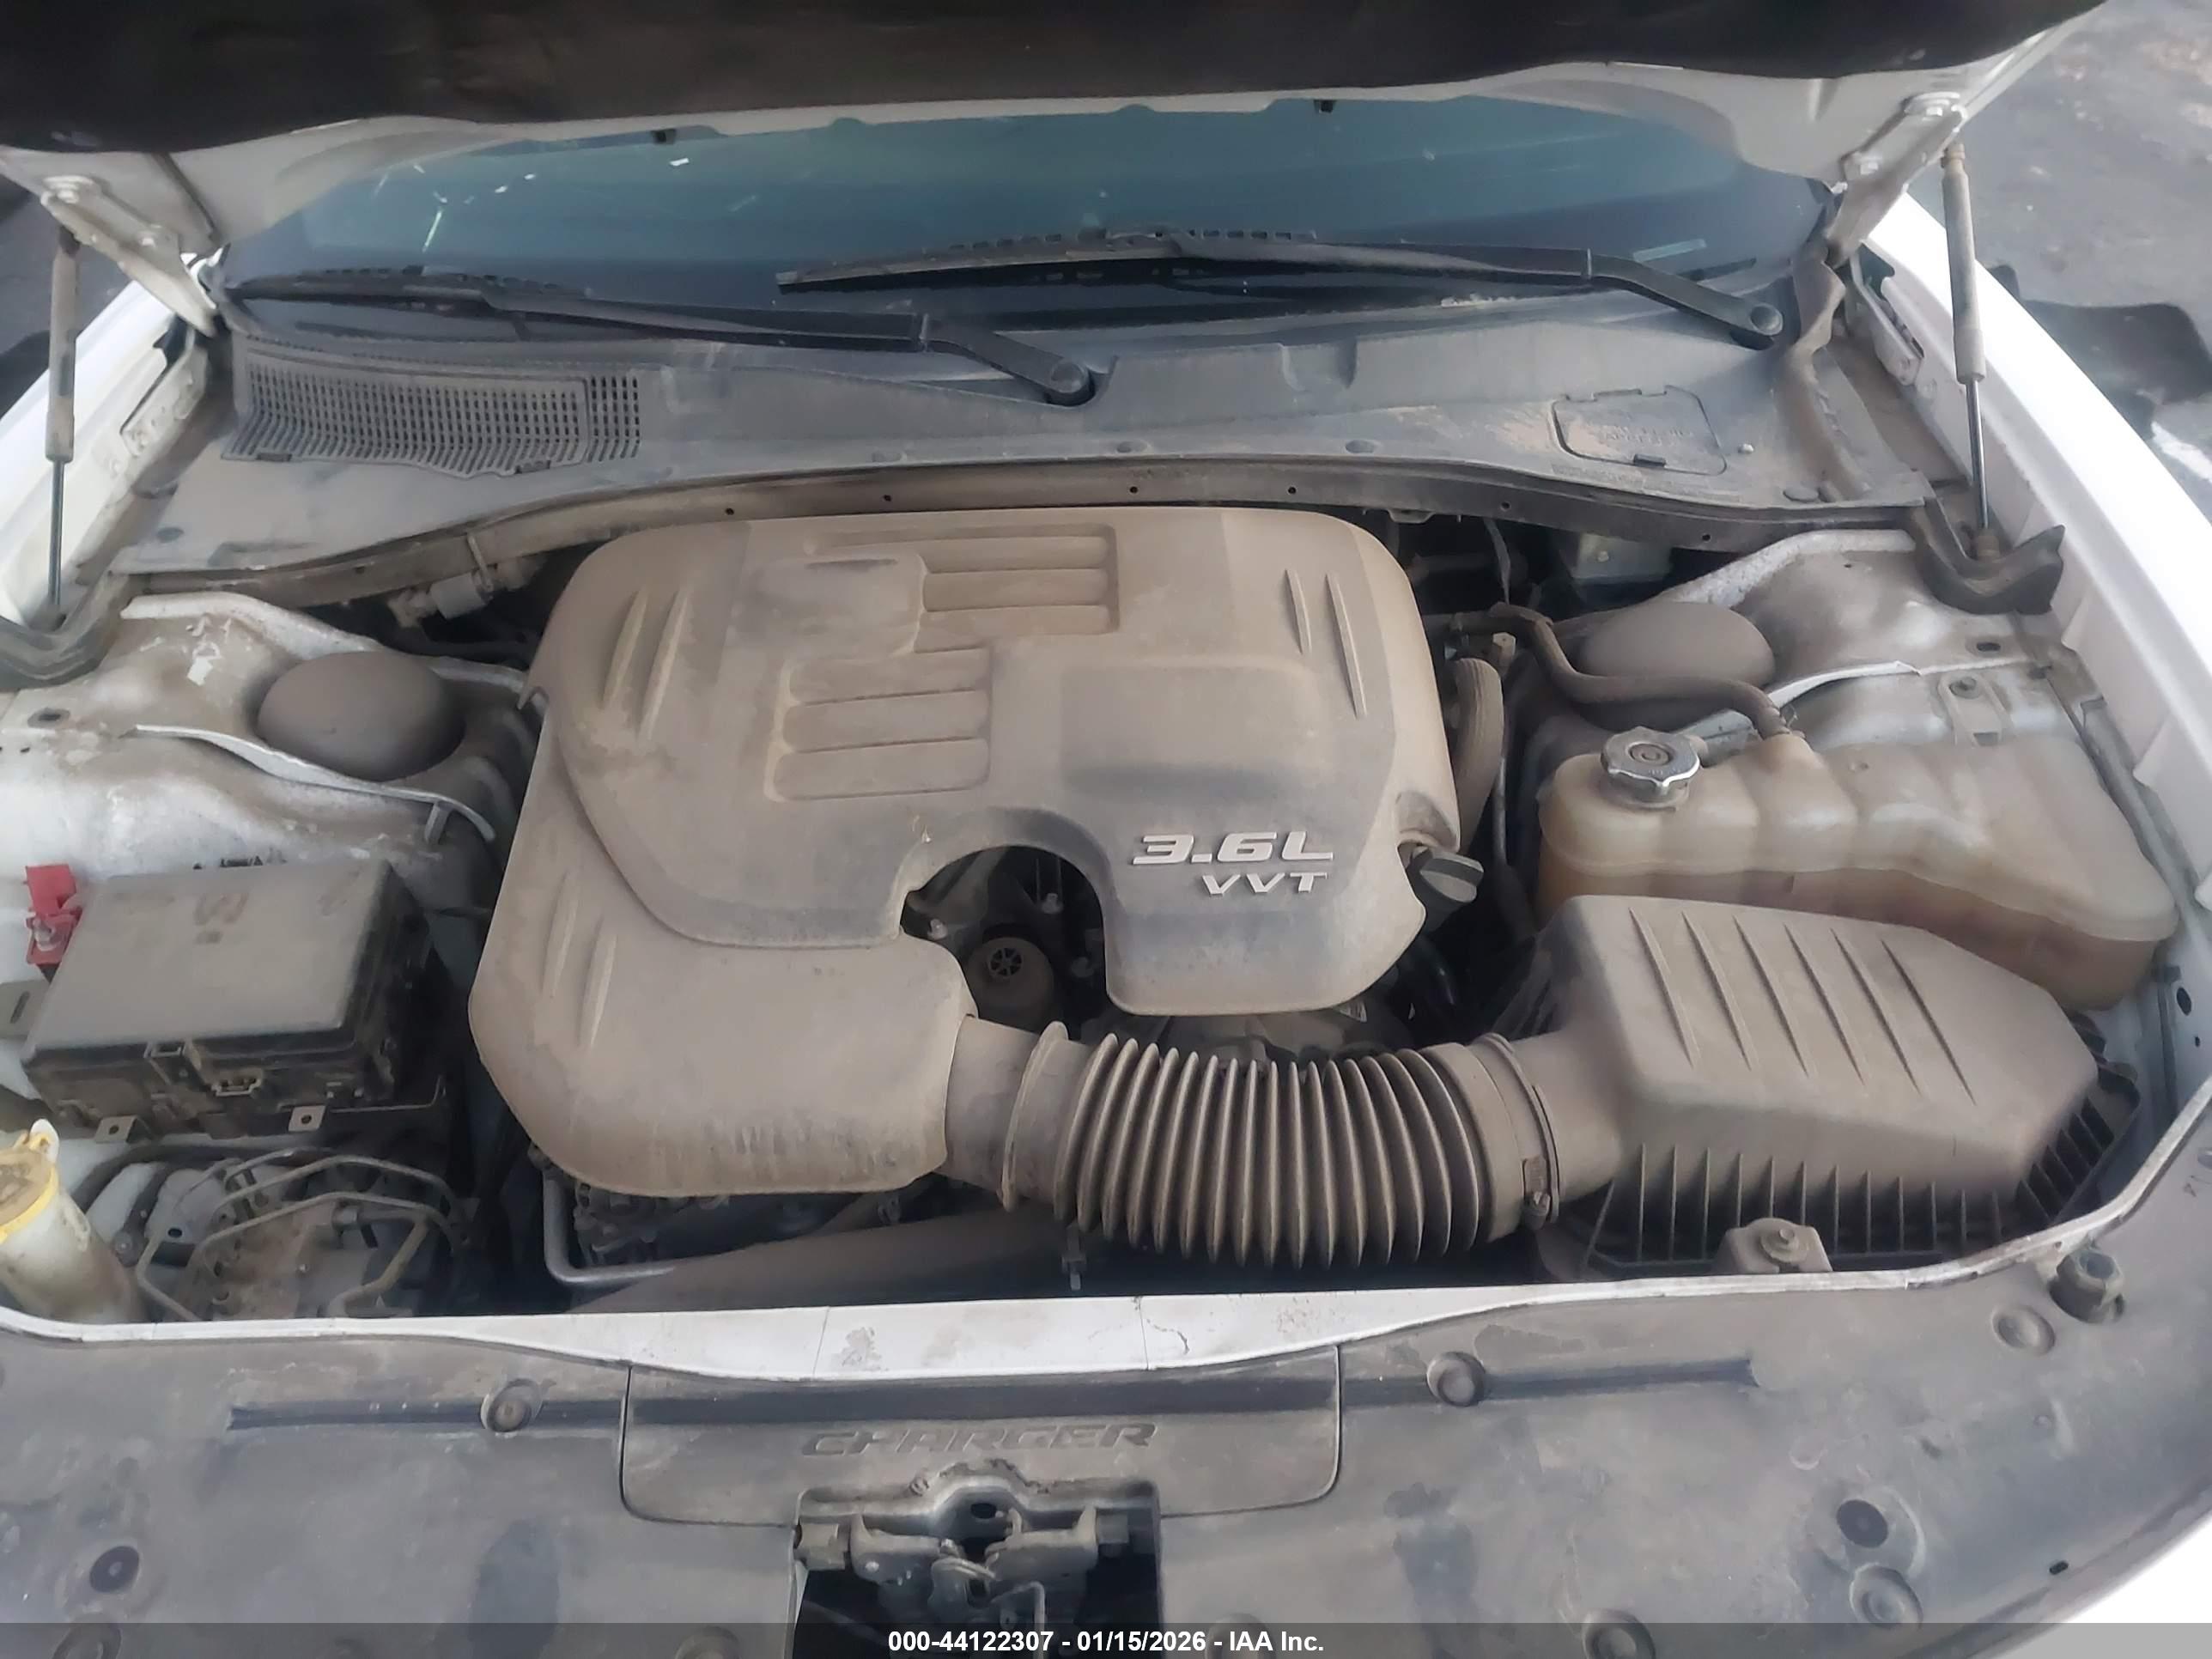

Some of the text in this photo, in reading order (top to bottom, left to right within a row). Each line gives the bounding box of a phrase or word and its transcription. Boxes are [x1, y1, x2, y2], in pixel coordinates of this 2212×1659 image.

[1132, 830, 1334, 866] 3.6L
[1201, 872, 1328, 896] VVT
[801, 1422, 1158, 1456] CHARGER
